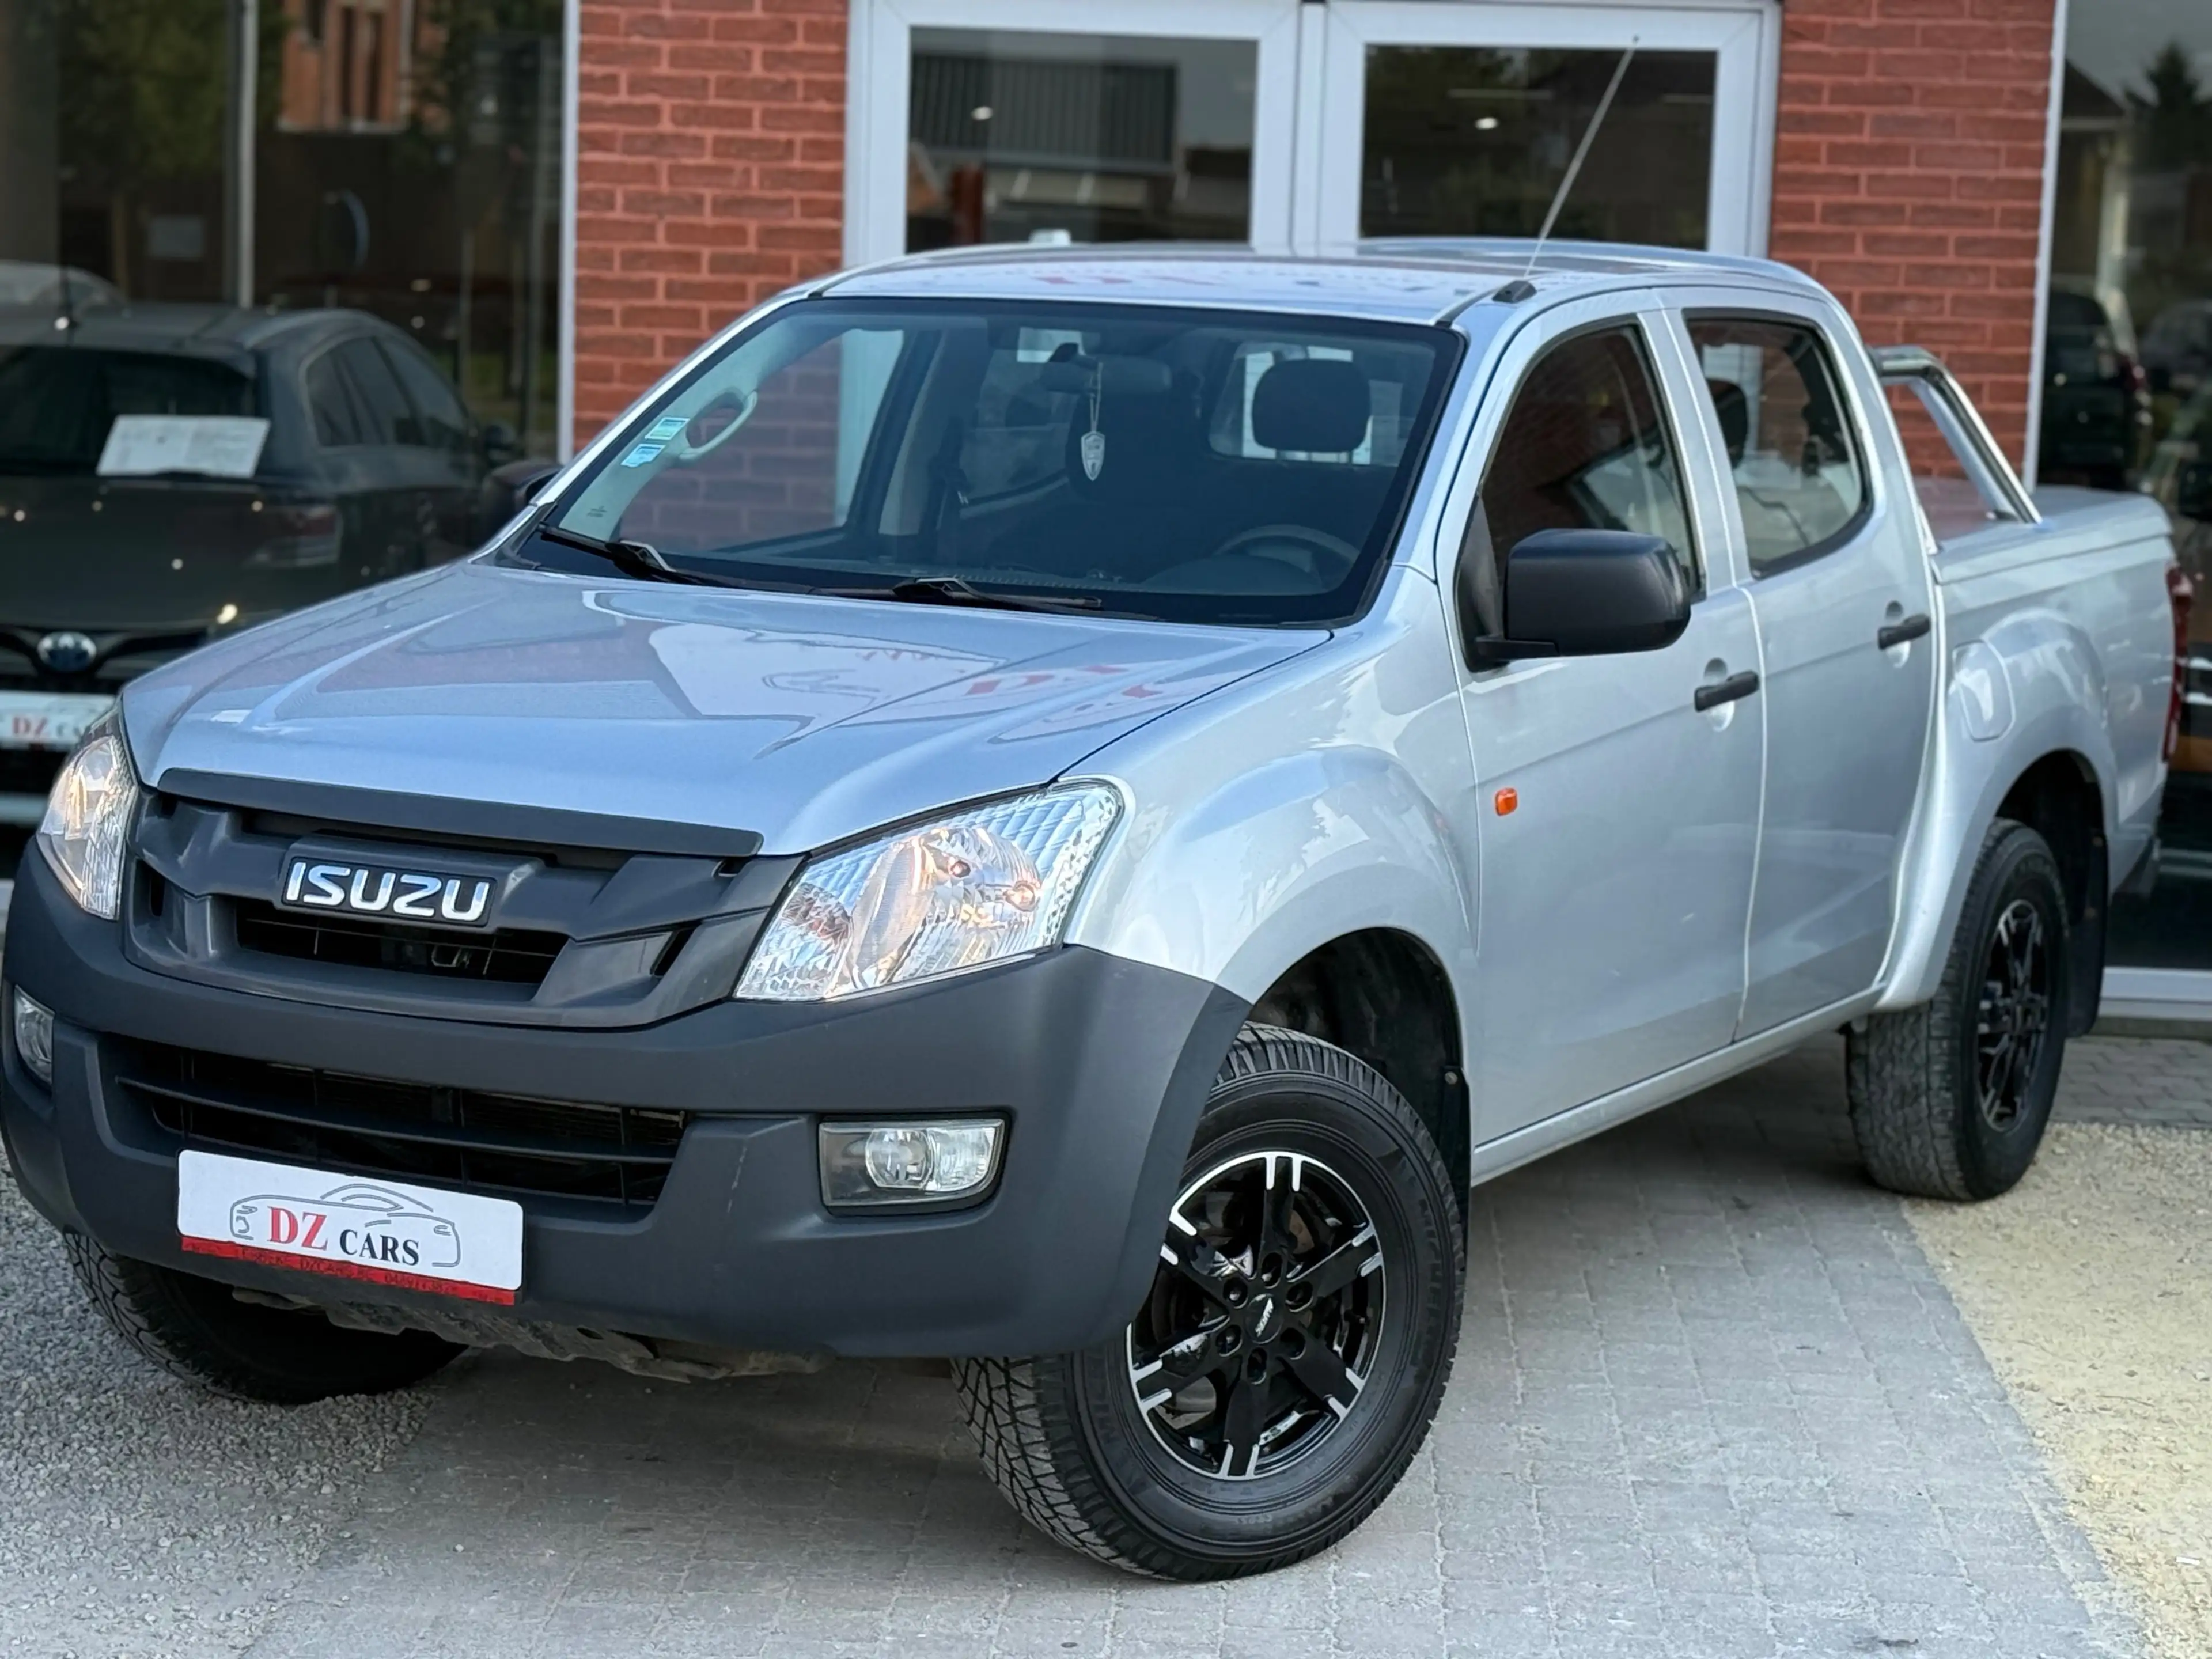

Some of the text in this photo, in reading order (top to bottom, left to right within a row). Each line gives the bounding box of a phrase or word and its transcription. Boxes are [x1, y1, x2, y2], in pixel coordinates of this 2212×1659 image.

[12, 716, 48, 736] DZ
[286, 862, 490, 921] ISUZU
[267, 1206, 419, 1266] DZ CARS
